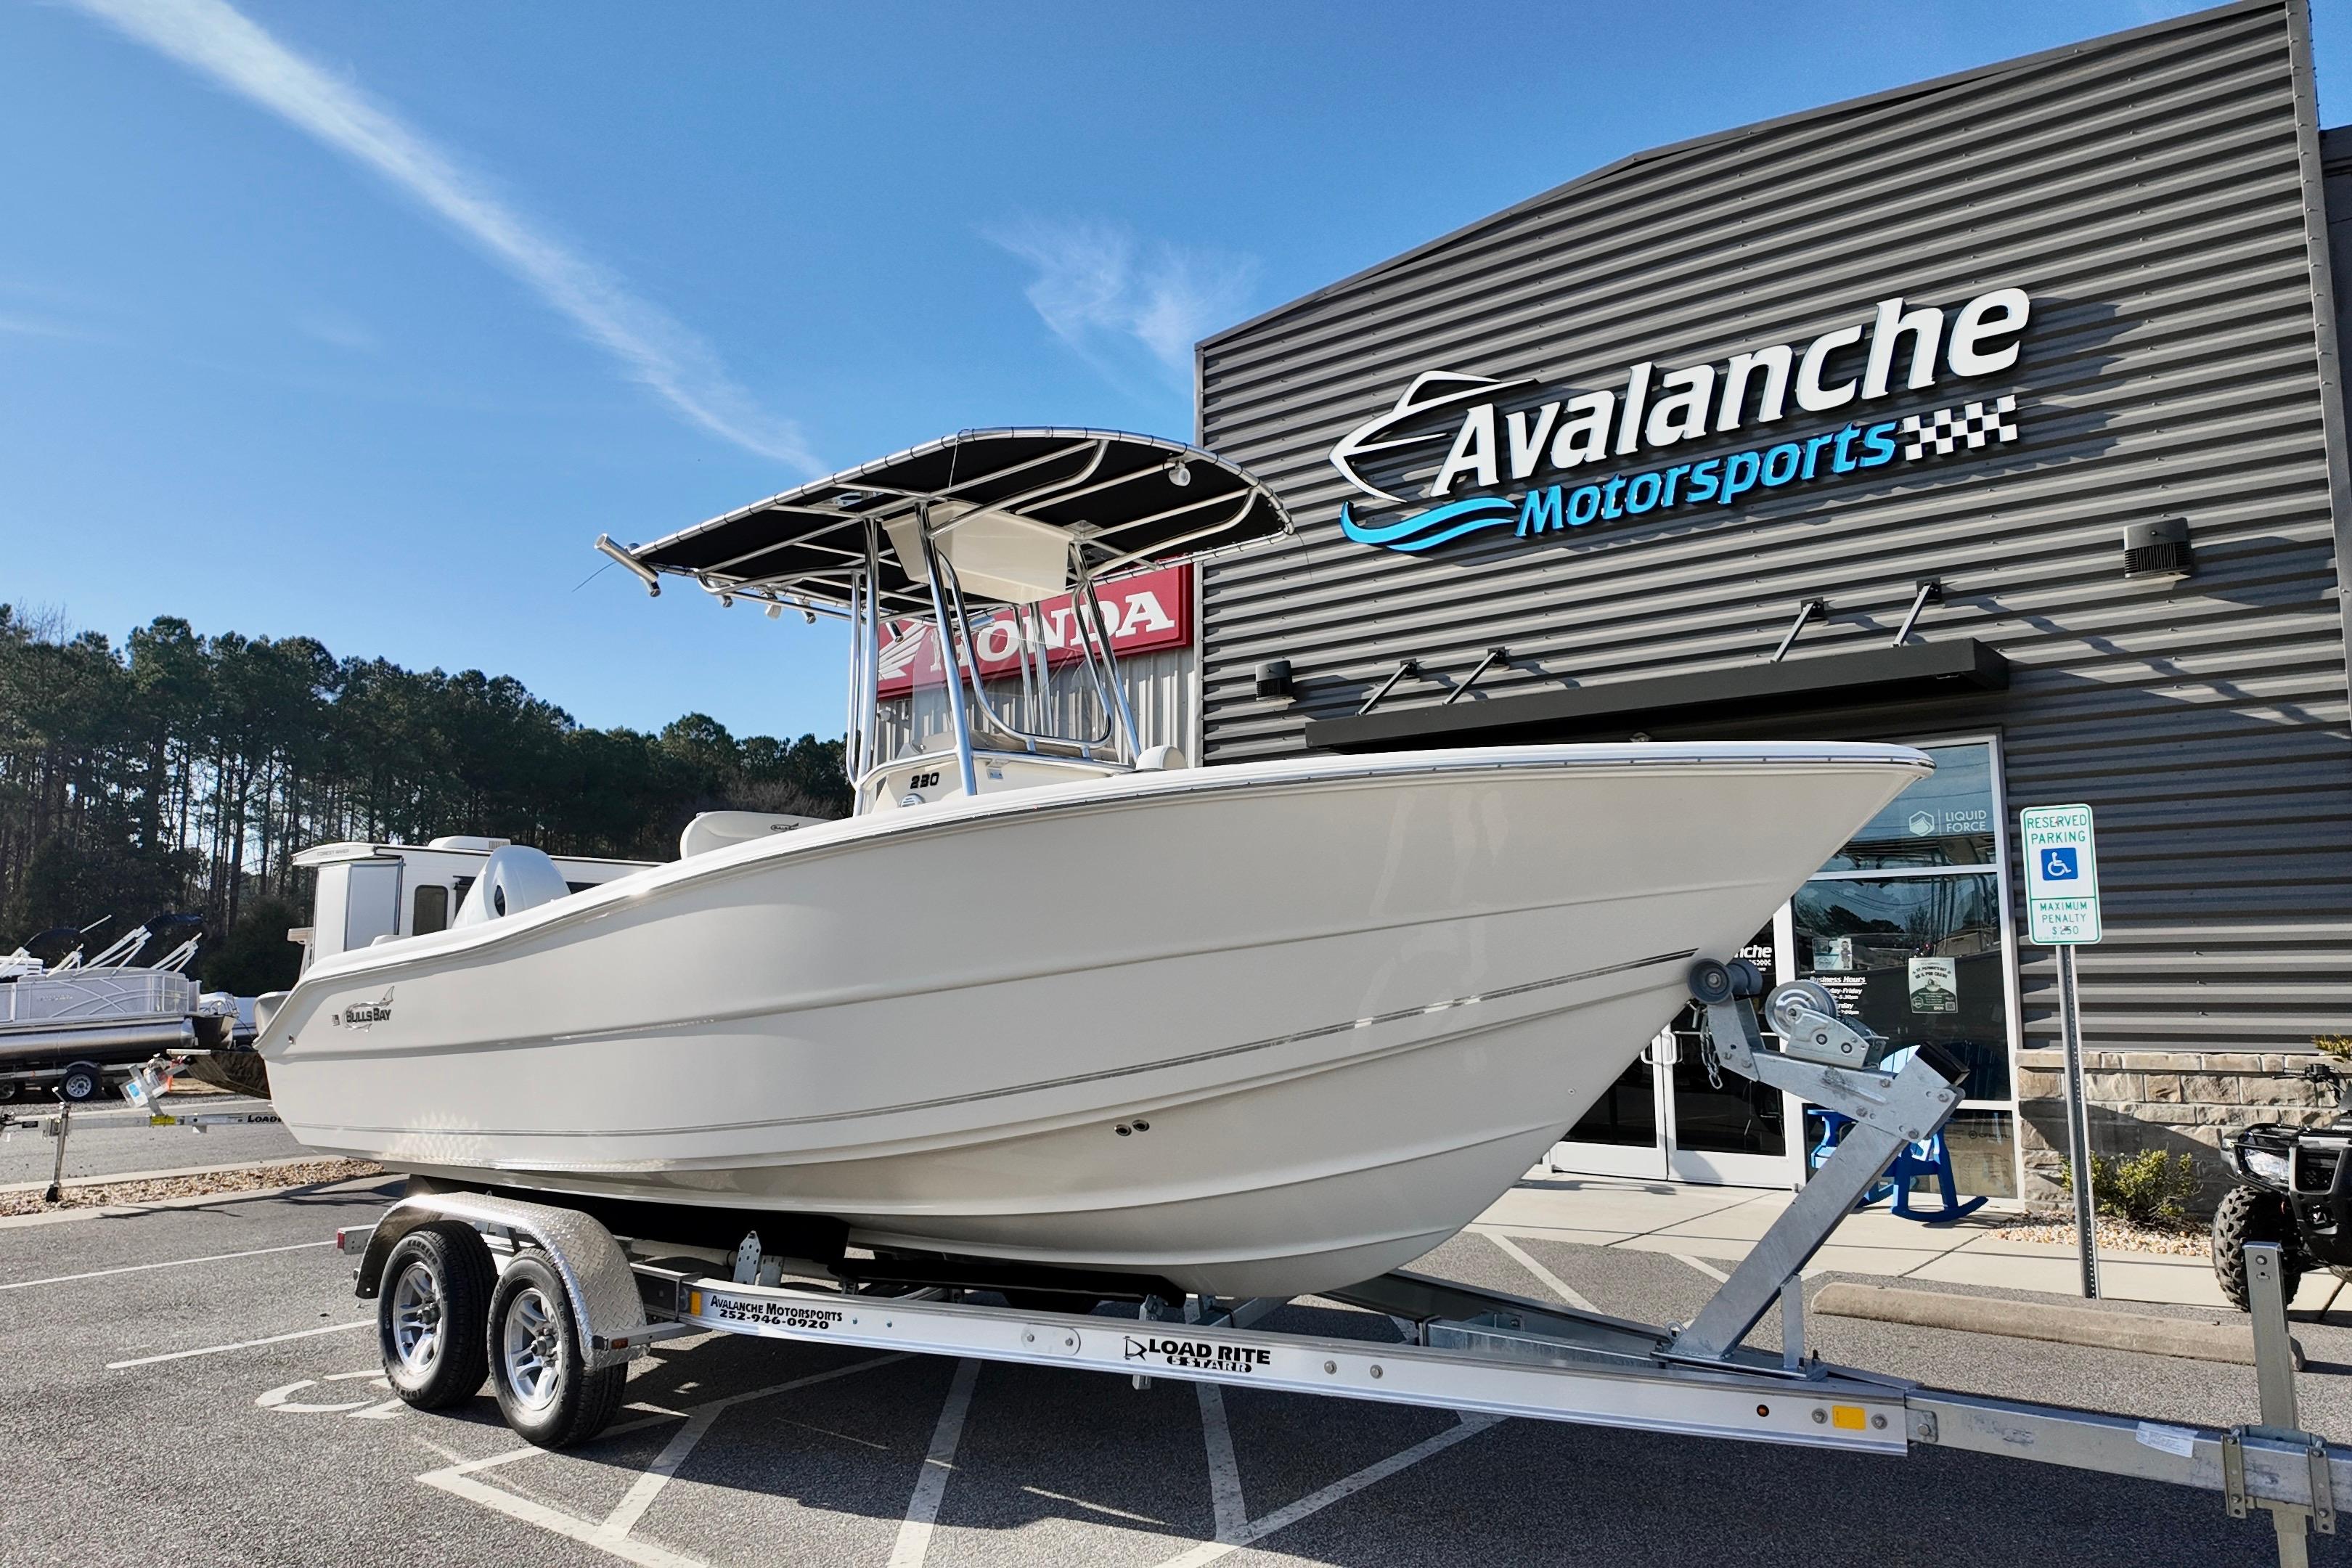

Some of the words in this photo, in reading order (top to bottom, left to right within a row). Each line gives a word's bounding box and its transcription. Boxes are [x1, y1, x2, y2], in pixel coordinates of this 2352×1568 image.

[1429, 287, 2030, 497] Avalanche
[1514, 420, 1898, 537] Motorsports
[1945, 810, 1987, 822] LIQUID
[2027, 814, 2088, 829] RESERVED
[1946, 821, 1987, 833] FORCE
[2032, 830, 2086, 844] PARKING
[2040, 901, 2088, 911] MAXIMUM
[2042, 913, 2086, 923] PENALTY
[710, 1295, 764, 1313] AVALANCHE
[766, 1302, 843, 1322] MOTORSPORTS
[719, 1308, 829, 1330] 252-946-0920
[1148, 1338, 1212, 1358] LOAD
[1218, 1345, 1271, 1365] RITE
